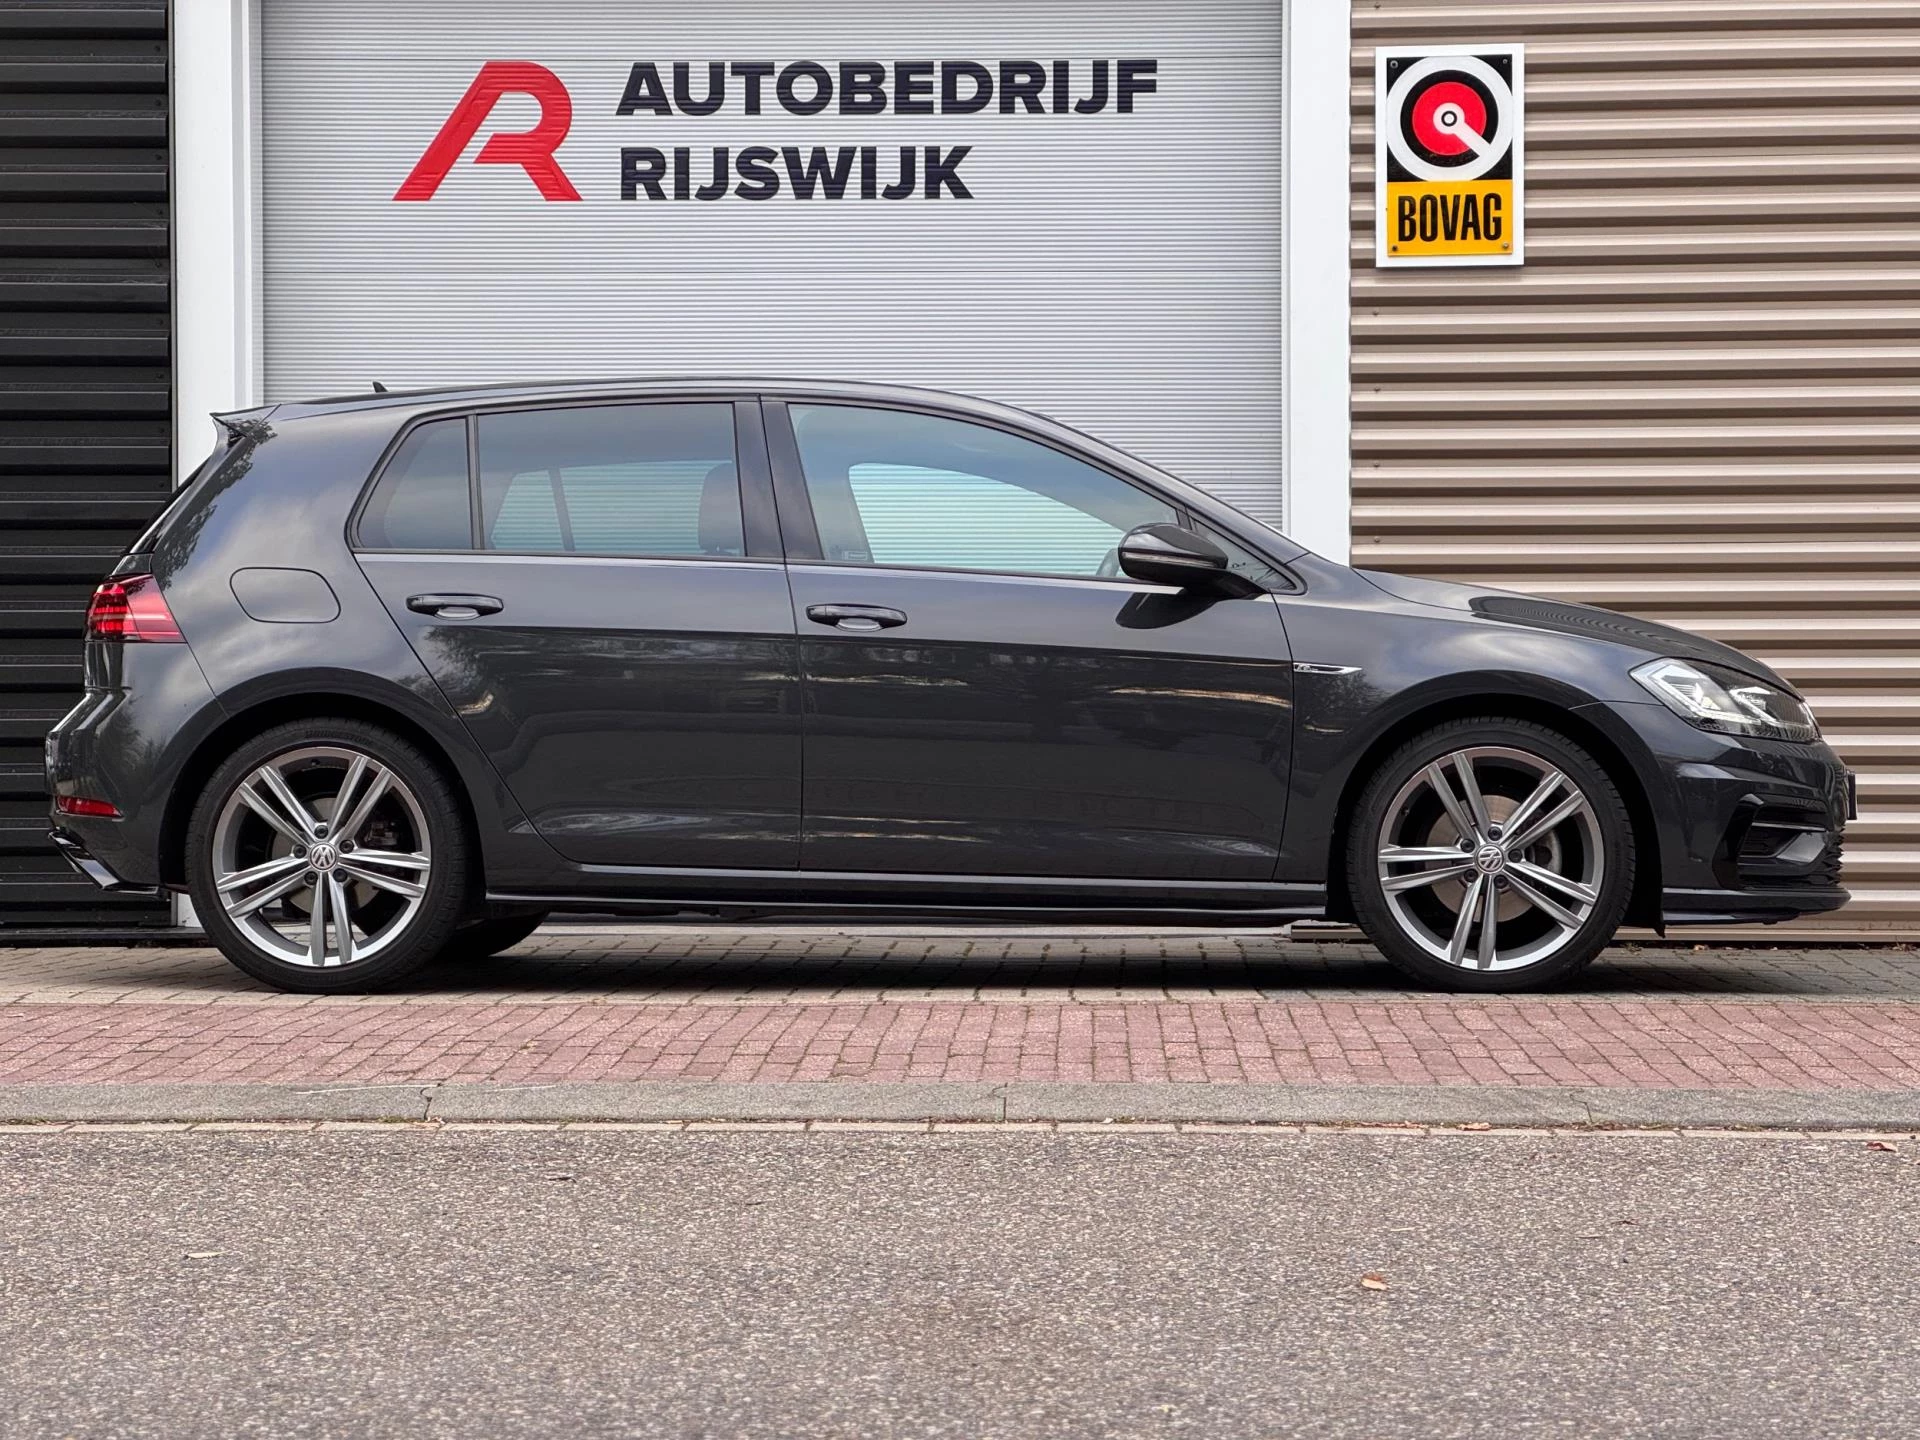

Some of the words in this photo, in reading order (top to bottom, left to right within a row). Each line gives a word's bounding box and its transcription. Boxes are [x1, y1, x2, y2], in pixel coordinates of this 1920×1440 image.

[616, 59, 1158, 116] AUTOBEDRIJF
[620, 145, 974, 200] RIJSWIJK
[1398, 193, 1502, 242] BOVAG
